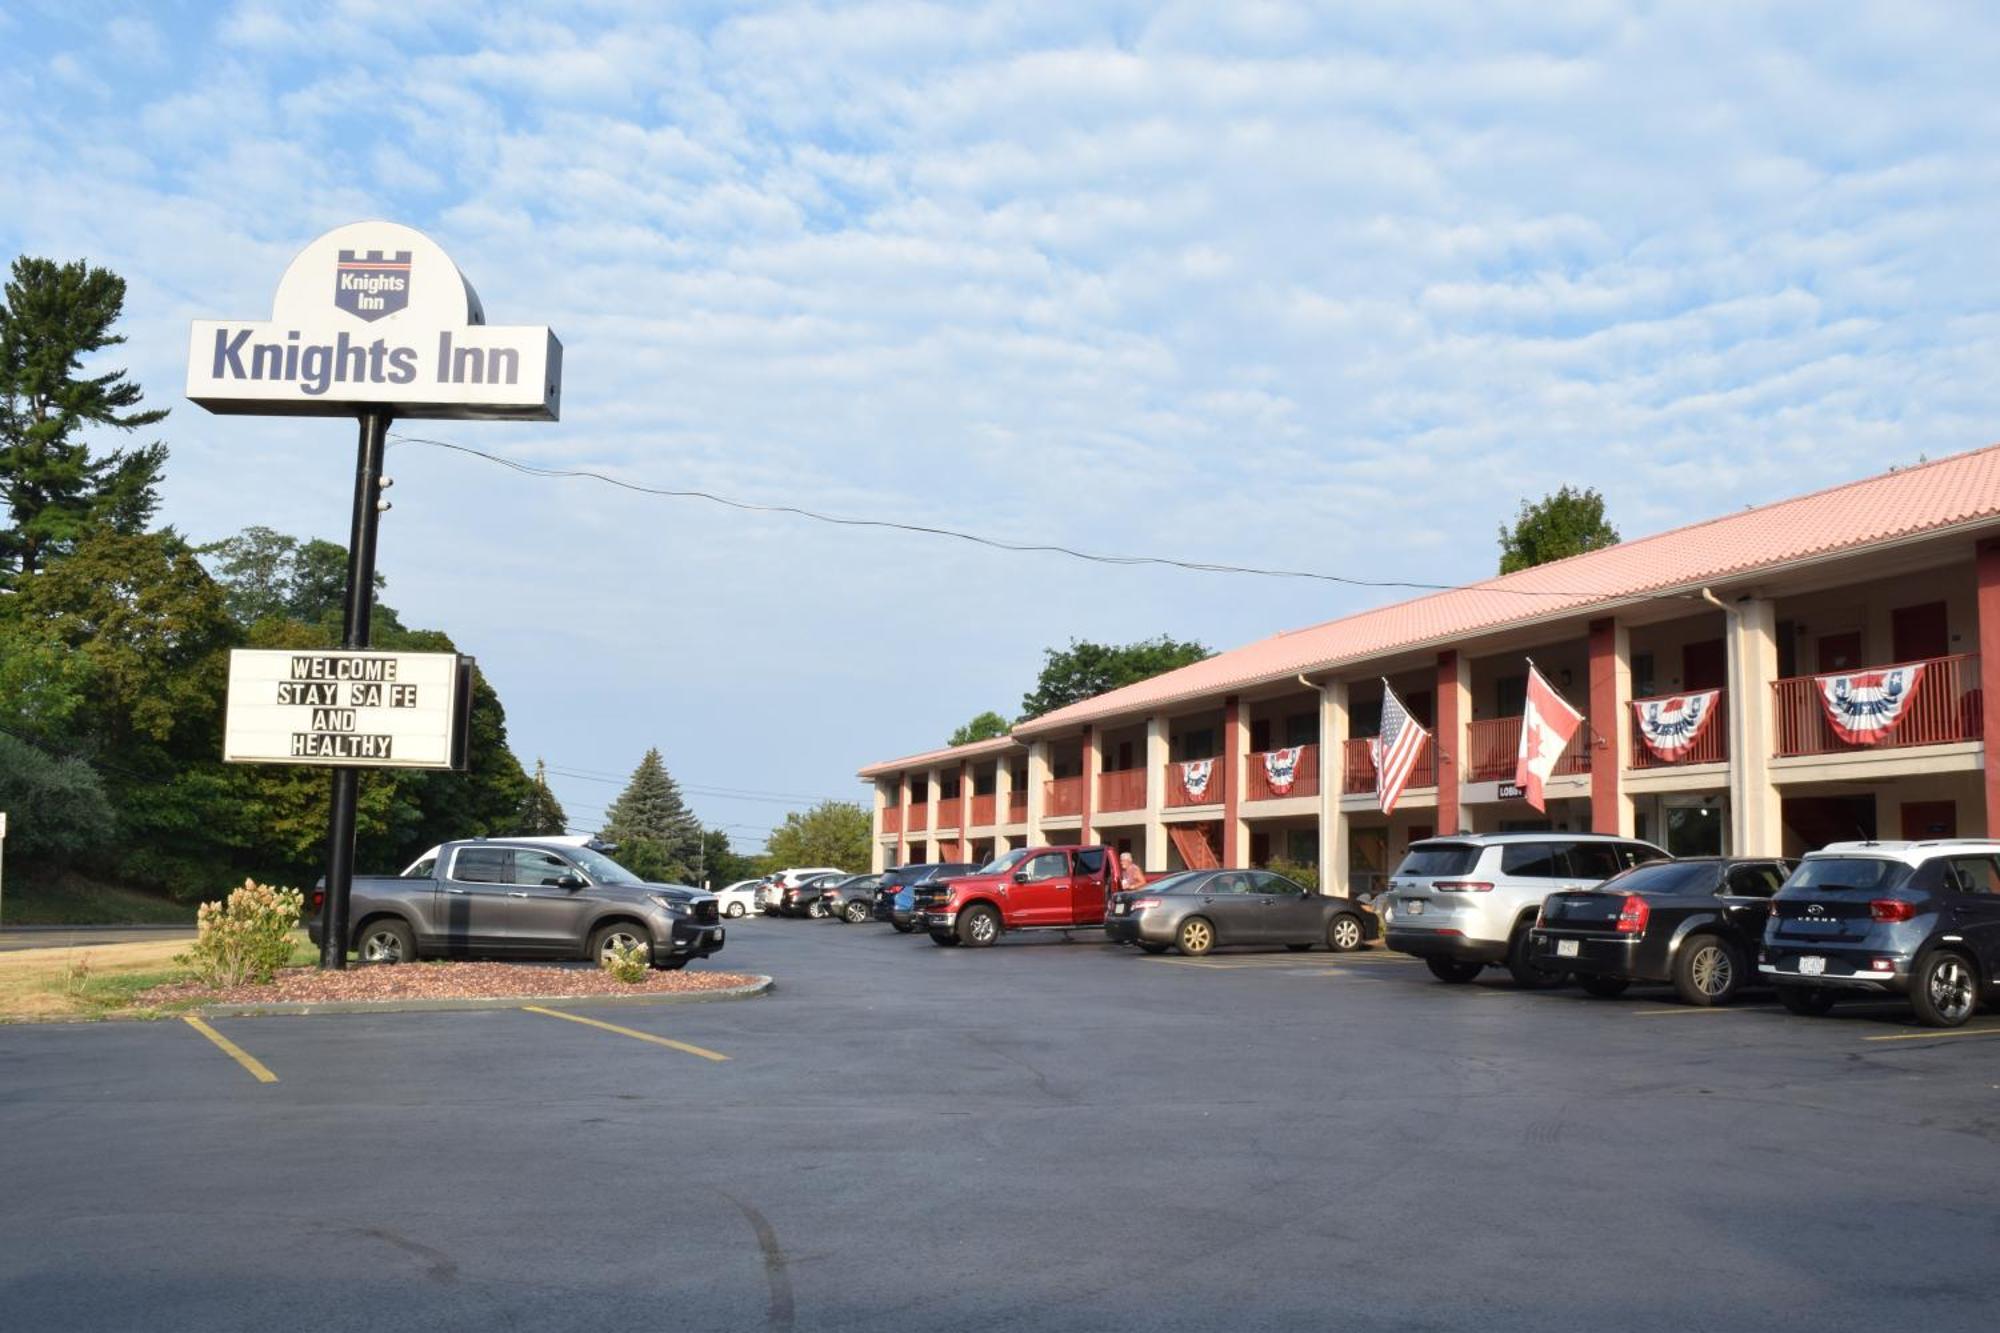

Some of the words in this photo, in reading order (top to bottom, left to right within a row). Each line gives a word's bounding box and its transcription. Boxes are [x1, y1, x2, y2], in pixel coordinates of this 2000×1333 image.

[341, 273, 405, 294] Knights
[358, 292, 384, 310] Inn
[212, 328, 418, 395] Knights
[436, 331, 520, 385] Inn
[293, 657, 396, 681] WELCOME
[278, 683, 337, 705] STAY
[313, 709, 356, 731] AND
[292, 734, 391, 758] HEALTHY
